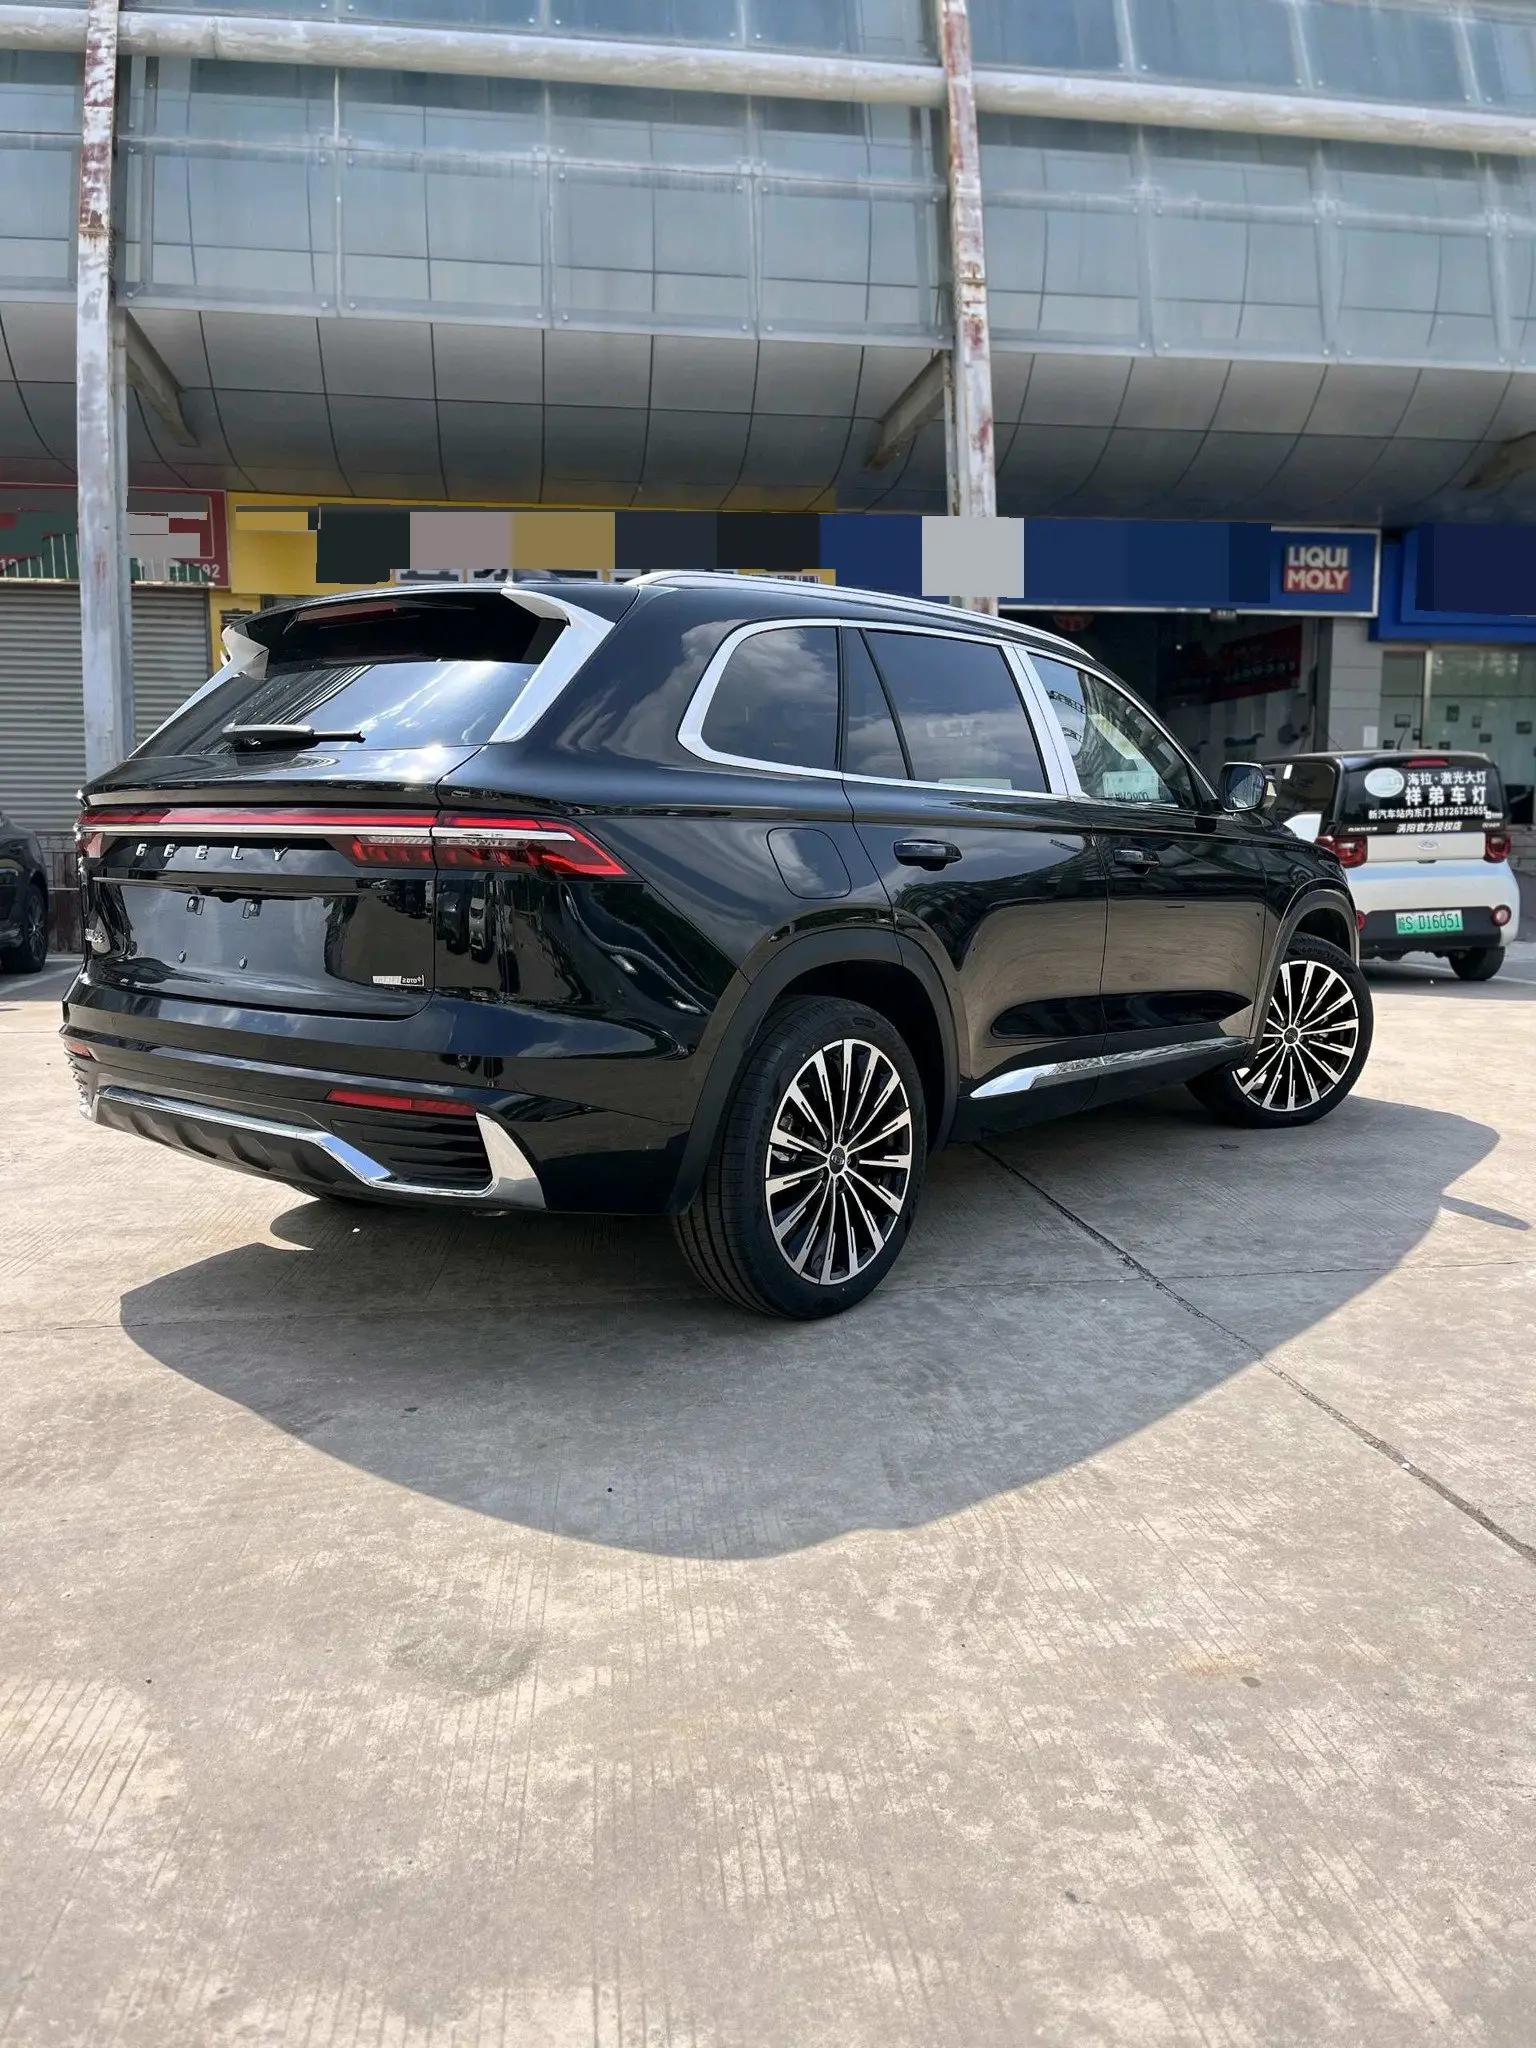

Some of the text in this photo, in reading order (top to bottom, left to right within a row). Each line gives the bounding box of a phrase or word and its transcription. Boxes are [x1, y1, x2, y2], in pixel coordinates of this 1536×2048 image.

[1288, 546, 1348, 568] LIQUI
[1287, 569, 1349, 590] MOLY
[135, 843, 289, 861] GEELY
